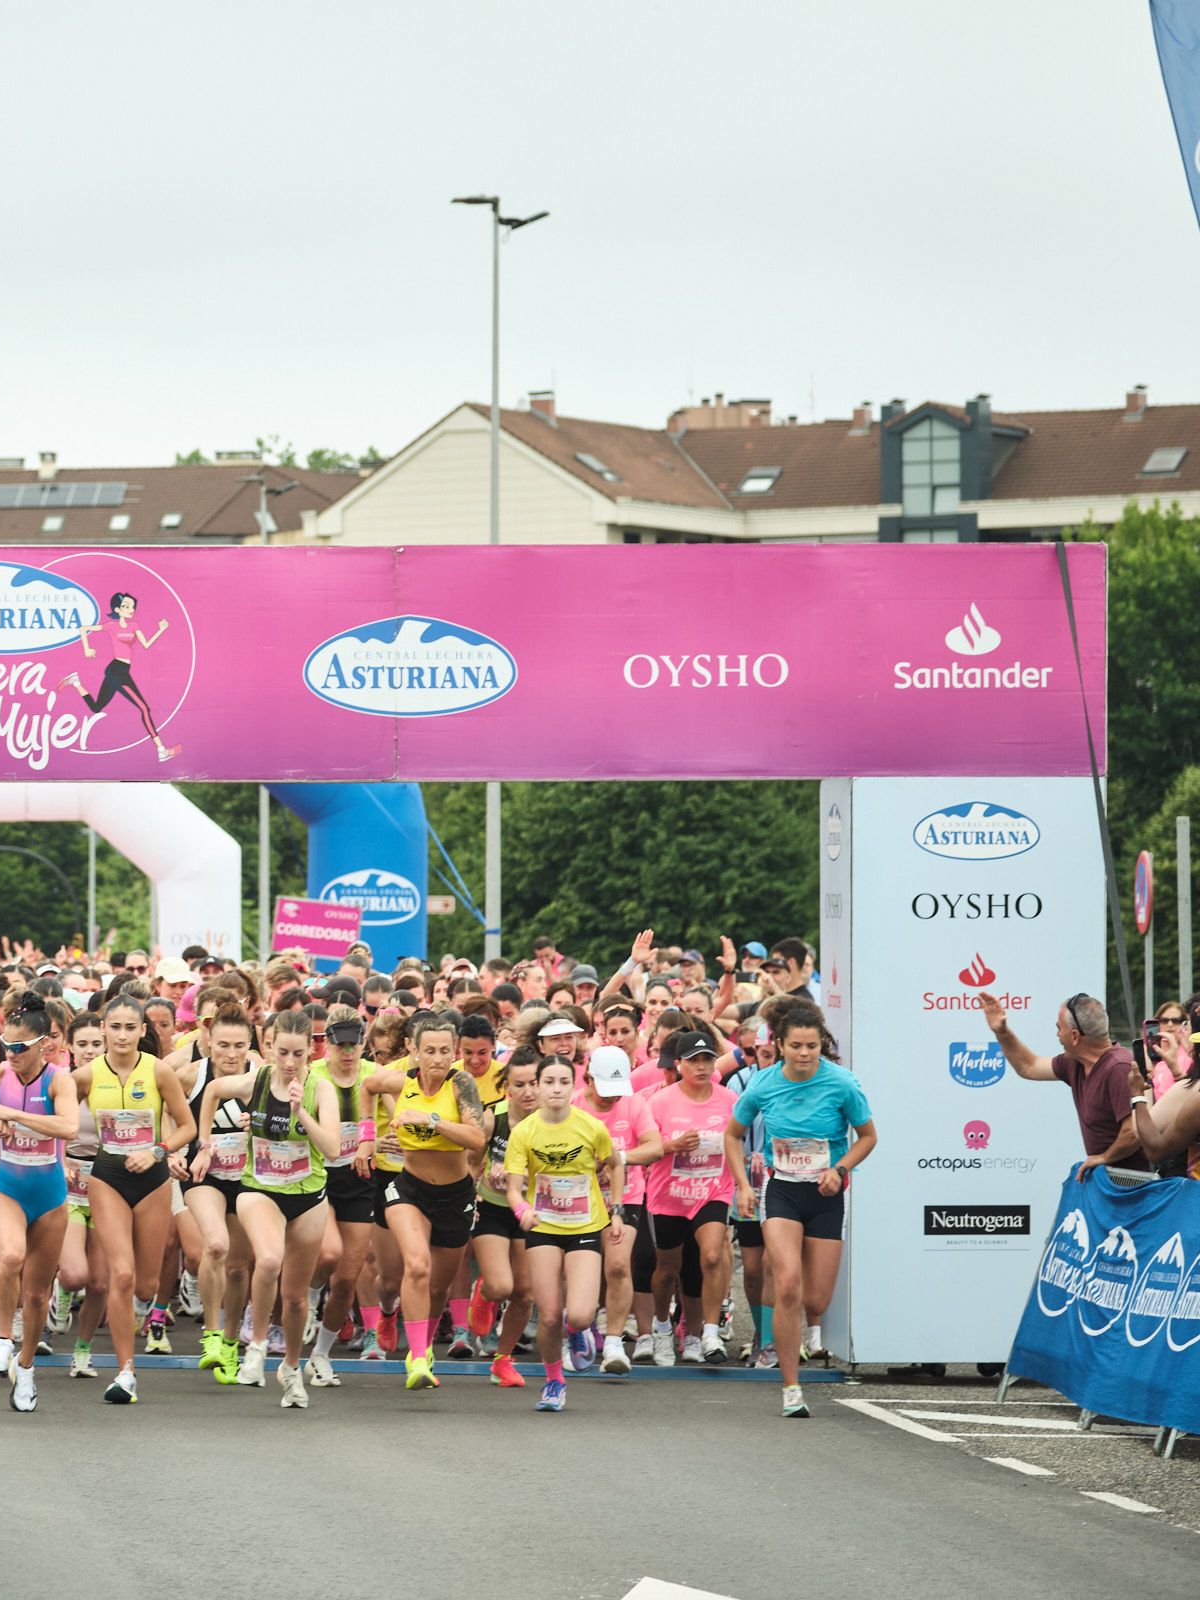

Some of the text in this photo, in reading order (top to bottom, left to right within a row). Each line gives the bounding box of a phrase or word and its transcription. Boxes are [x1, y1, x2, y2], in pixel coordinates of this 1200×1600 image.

[16, 593, 79, 603] LECHERA
[354, 651, 493, 660] CENTRAL LECHERA
[321, 653, 500, 690] ASTURIANA
[623, 653, 789, 688] OYSHO
[893, 661, 1053, 690] Santander
[923, 823, 1030, 845] ASTURIANA
[911, 893, 1043, 919] OYSHO
[276, 922, 357, 942] CORREDORAS
[922, 992, 1032, 1010] Santader
[952, 1052, 1003, 1076] Marlene
[16, 1137, 39, 1147] 016
[115, 1128, 138, 1139] 016
[271, 1159, 293, 1169] 016
[689, 1154, 709, 1164] 016
[791, 1156, 812, 1165] 016
[918, 1157, 1037, 1173] octopus energy
[551, 1197, 573, 1207] 016
[930, 1211, 1024, 1232] Neutrogena
